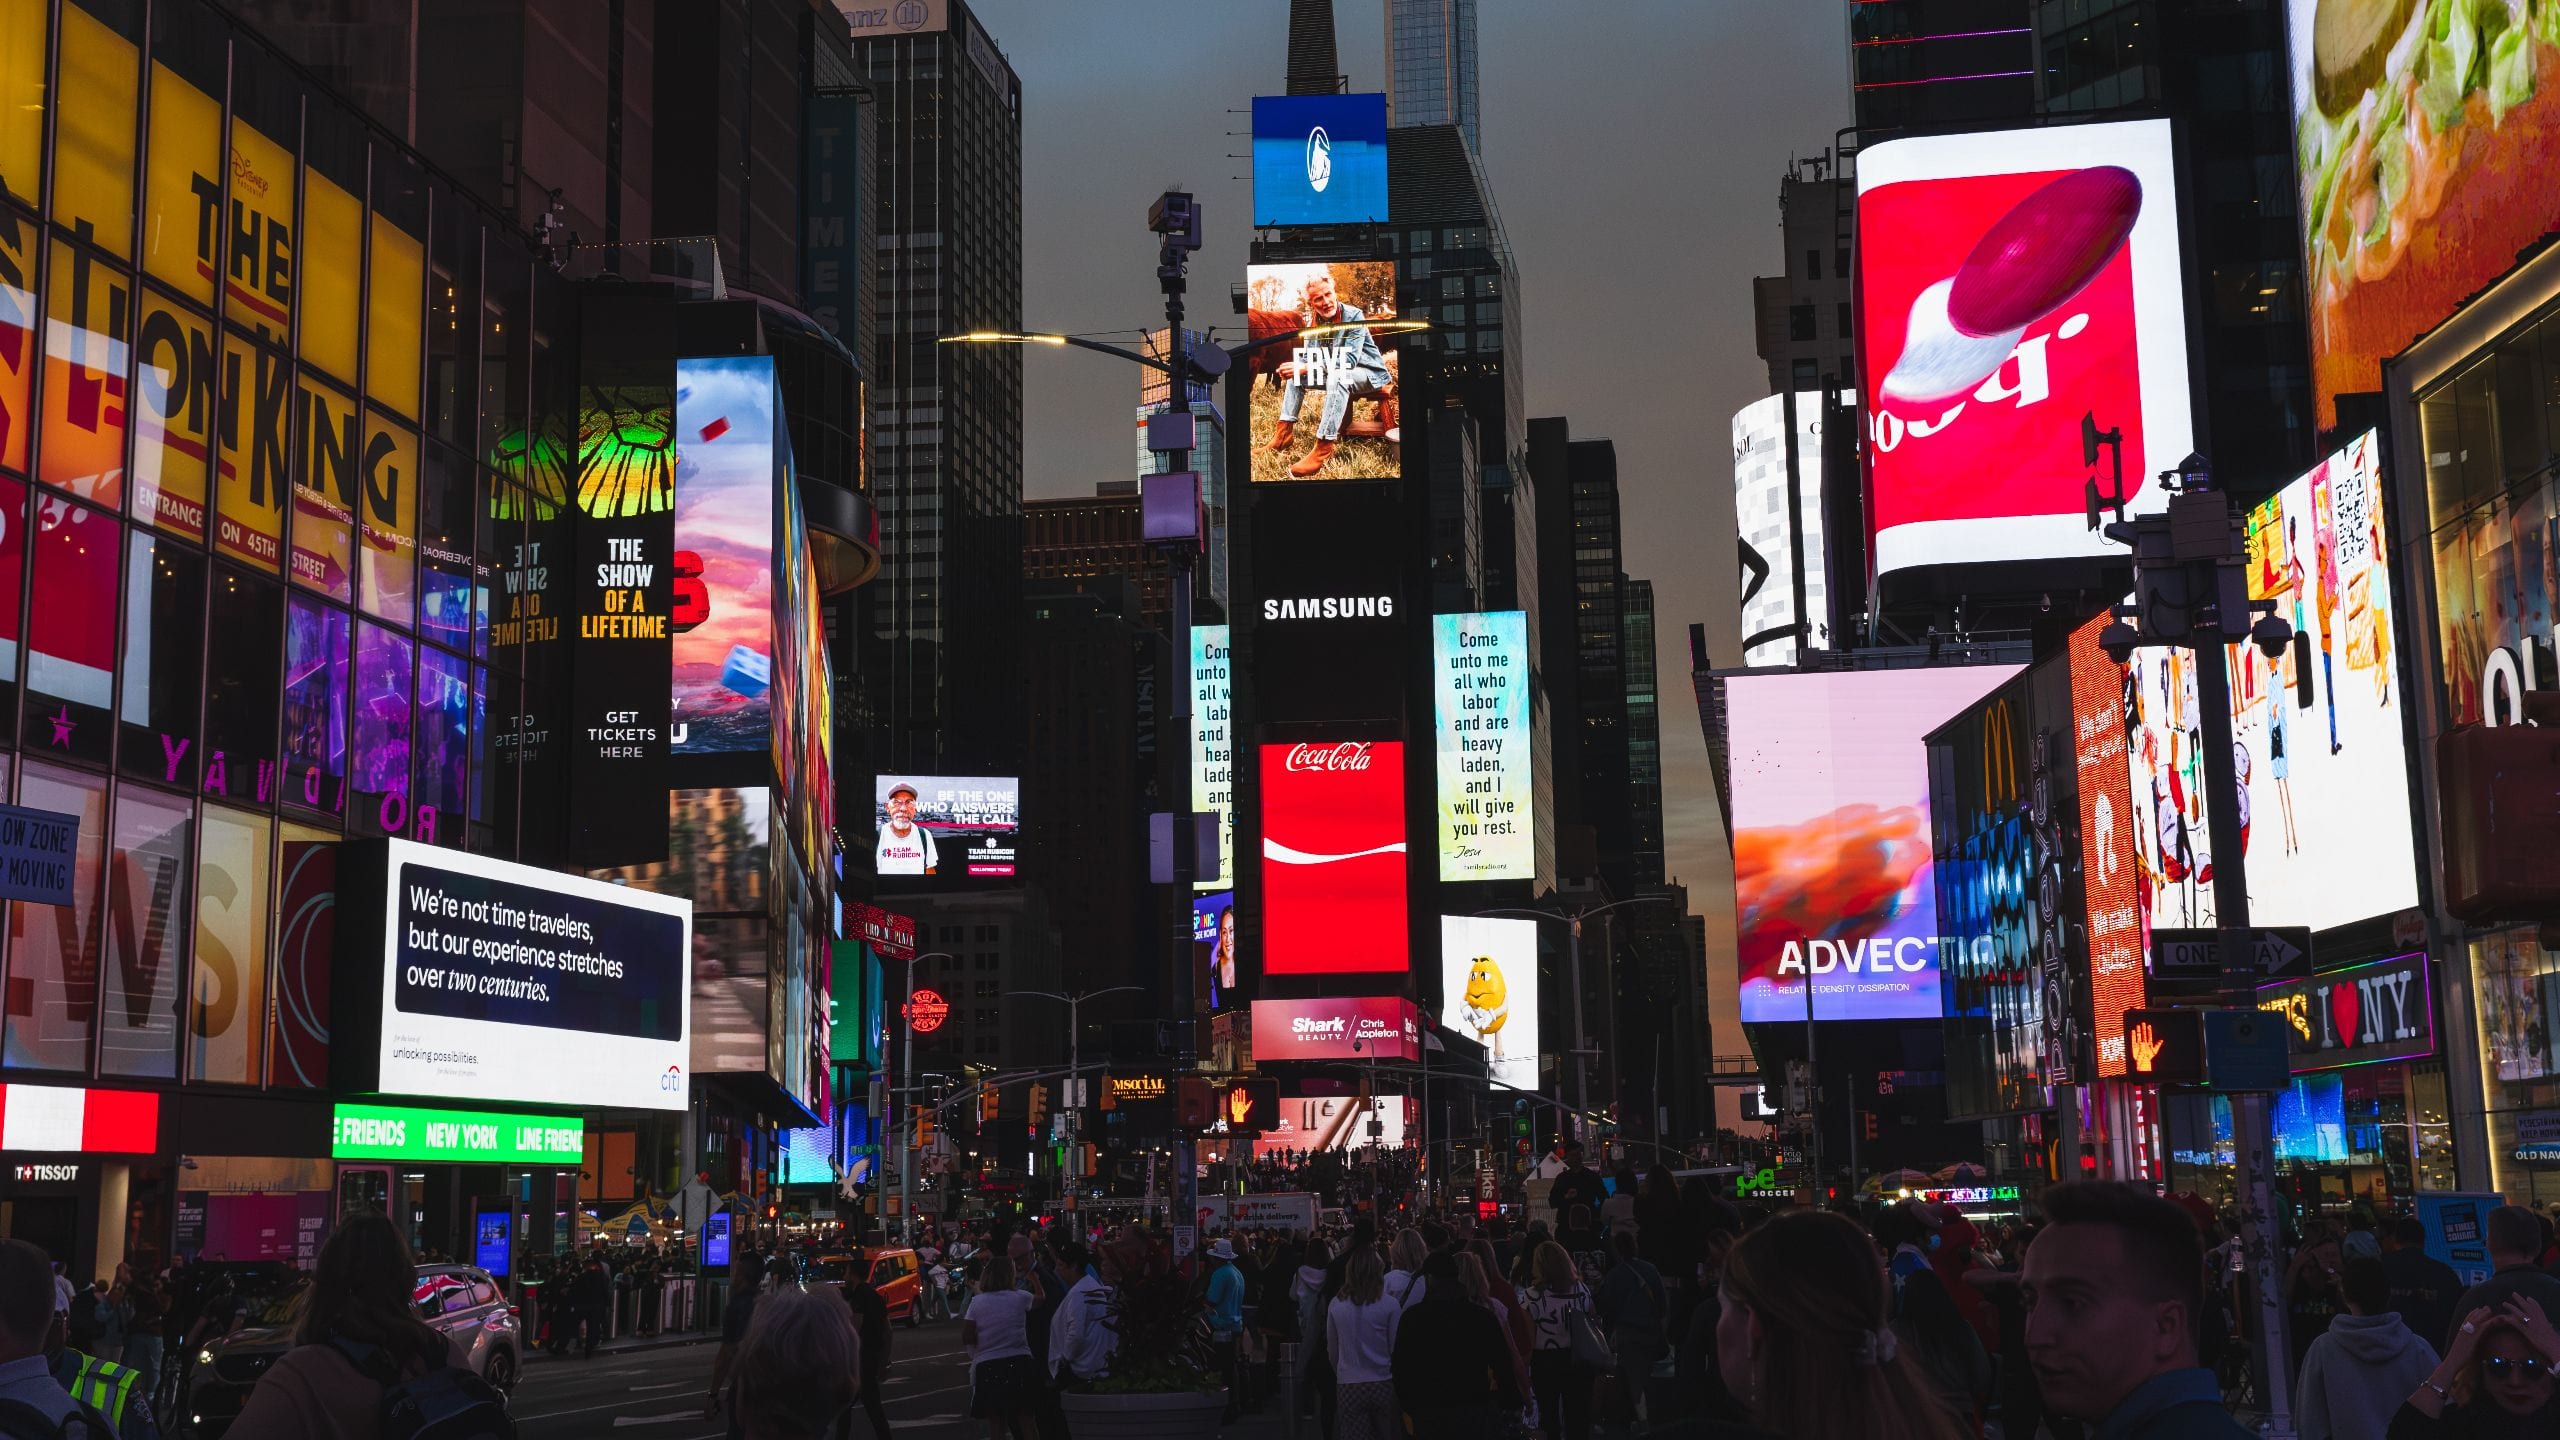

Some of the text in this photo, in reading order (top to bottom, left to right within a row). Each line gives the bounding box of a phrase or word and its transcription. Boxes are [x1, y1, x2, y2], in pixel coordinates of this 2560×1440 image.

[191, 170, 290, 307] THE
[66, 216, 399, 528] LION KING
[1292, 346, 1354, 387] FRYE
[138, 485, 327, 581] ENTRANCE ON 45TH STREET
[607, 538, 644, 562] THE
[597, 563, 654, 588] SHOW
[604, 588, 644, 613] OF A
[1263, 596, 1394, 620] SAMSUNG
[581, 615, 667, 639] LIFETIME
[1460, 631, 1498, 649] Come
[1451, 653, 1508, 669] unto me
[1196, 664, 1226, 681] unto
[1454, 672, 1506, 690] all who
[1199, 684, 1216, 700] all
[1462, 694, 1499, 710] labor
[606, 711, 639, 724] GET
[1454, 715, 1509, 731] and are
[586, 728, 657, 741] TICKETS
[1198, 725, 1223, 742] and
[600, 746, 643, 759] HERE
[1462, 735, 1503, 755] heavy
[1285, 741, 1376, 772] Coca-Cola
[1461, 756, 1505, 774] laden,
[1465, 777, 1491, 794] and
[937, 790, 1015, 802] BE THE ONE
[916, 801, 1015, 814] WHO ANSWERS
[1453, 797, 1514, 819] will give
[953, 813, 1014, 826] THE CALL
[29, 822, 69, 854] ZONE
[1453, 818, 1516, 841] you rest.
[9, 859, 66, 890] MOVING
[410, 885, 594, 945] We’re not time travelers,
[408, 922, 624, 979] but our experience stretches
[2175, 944, 2218, 963] ONE
[407, 964, 550, 1003] over two centuries.
[1778, 982, 1910, 995] RELATIE DENSITY DISSIPATION
[914, 993, 936, 1003] HOT
[914, 1018, 937, 1029] NOW
[1291, 1016, 1385, 1033] Shark Chris
[2317, 985, 2334, 1048] I
[1297, 1029, 1399, 1041] BEAUTY Appleton
[393, 1047, 480, 1065] unlocking possibilities.
[661, 1065, 681, 1092] citi
[342, 1117, 406, 1147] FRIENDS
[426, 1122, 462, 1149] NEW
[463, 1124, 499, 1150] YORK
[516, 1126, 543, 1151] LINE
[2515, 1150, 2537, 1160] OLD
[33, 1164, 80, 1181] TISSOT
